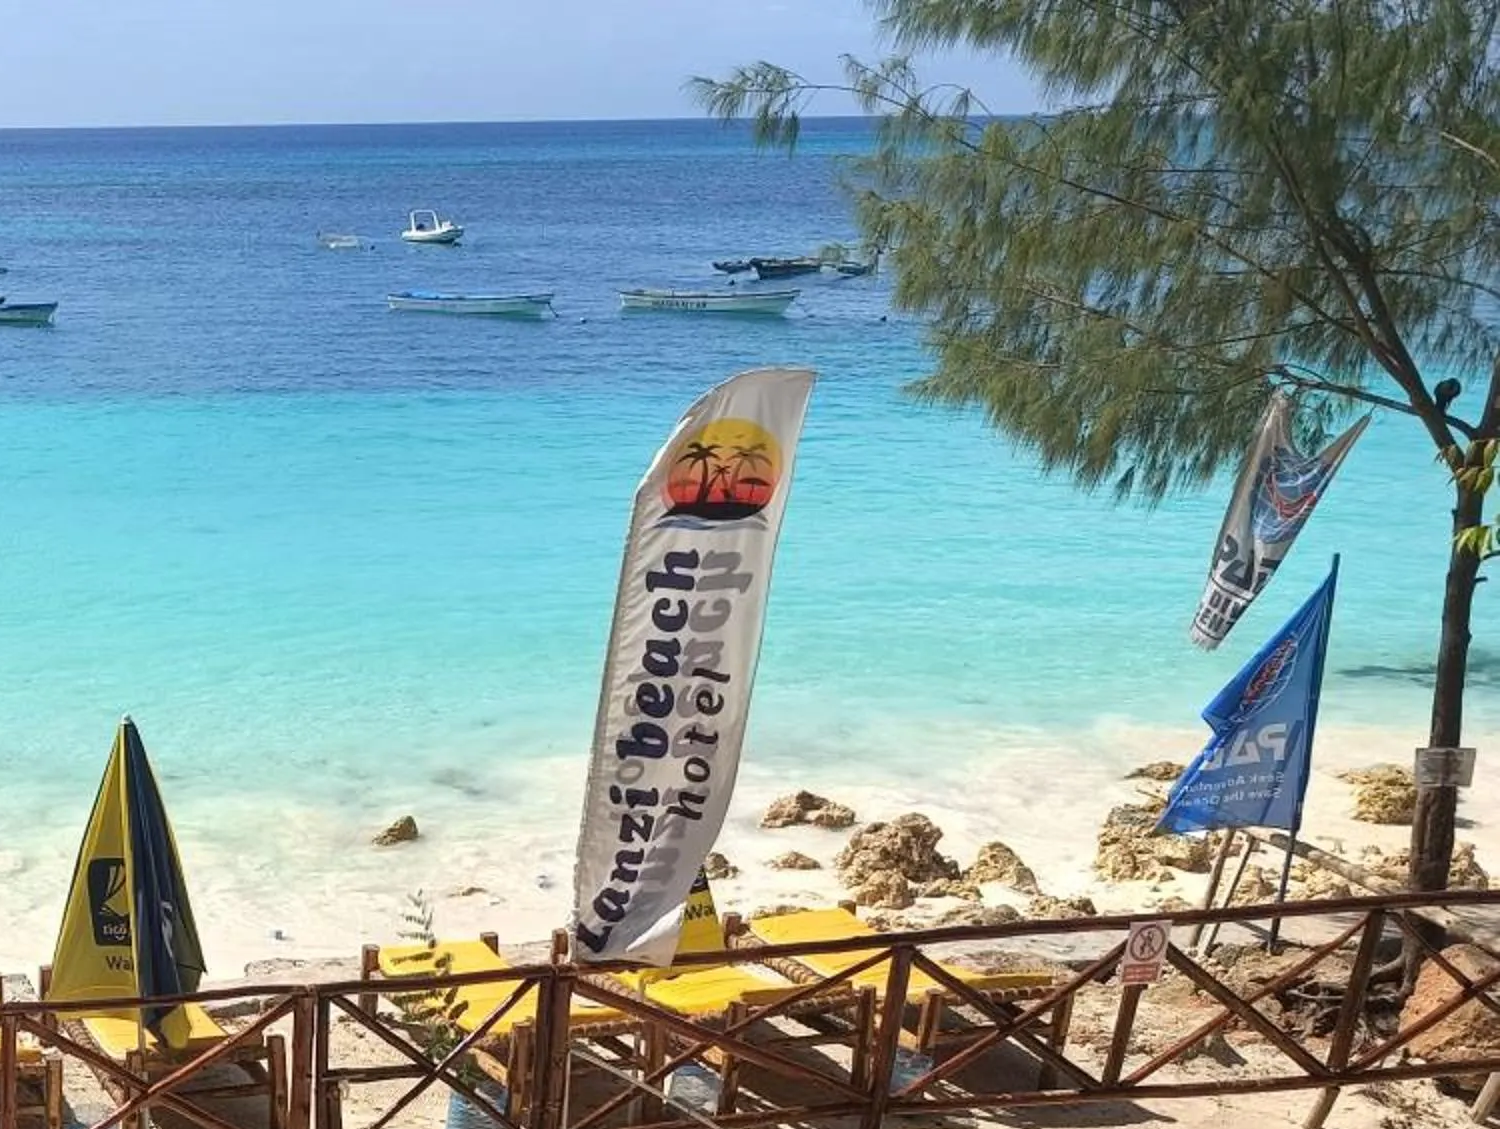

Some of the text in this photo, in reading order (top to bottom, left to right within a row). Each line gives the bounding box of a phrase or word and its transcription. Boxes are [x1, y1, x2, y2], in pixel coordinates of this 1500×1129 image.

[575, 547, 701, 953] Zanzi beach
[667, 667, 731, 821] hotel
[105, 955, 134, 971] Wa
